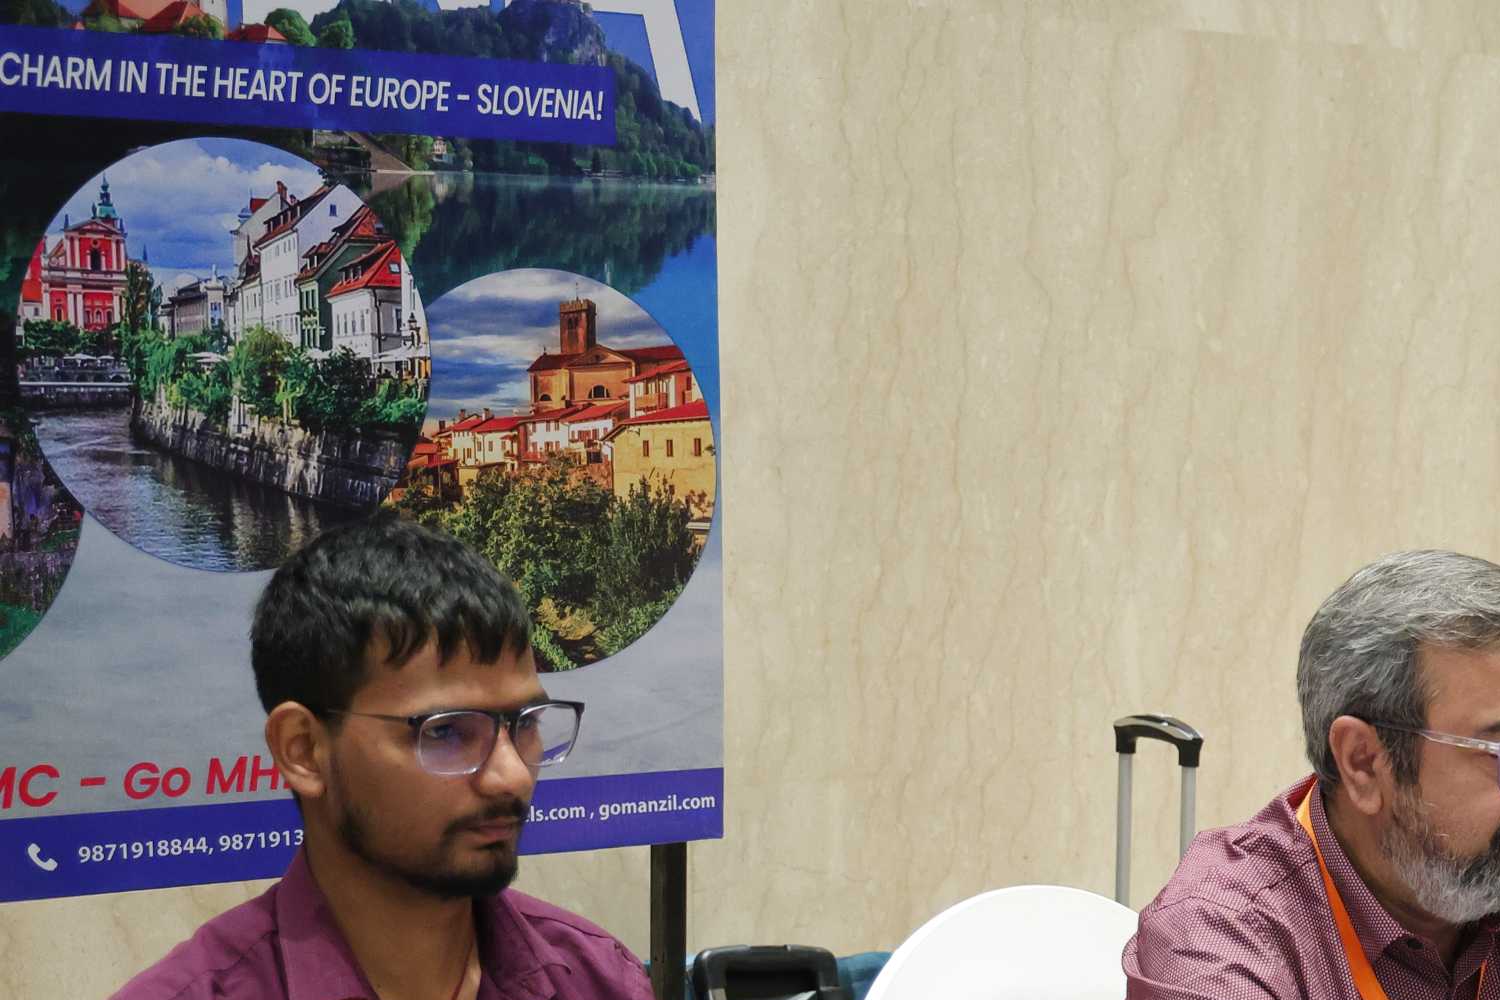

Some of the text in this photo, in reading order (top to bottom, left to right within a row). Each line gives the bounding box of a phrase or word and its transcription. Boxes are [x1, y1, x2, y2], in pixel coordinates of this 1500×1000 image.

[0, 52, 112, 92] CHARM
[118, 60, 149, 94] IN
[156, 63, 208, 97] THE
[213, 67, 304, 103] HEART
[308, 73, 346, 105] OF
[350, 75, 451, 112] EUROPE
[477, 84, 604, 121] SLOVENIA!
[124, 762, 191, 800] Go
[206, 755, 291, 794] MH
[525, 805, 586, 822] ls.com
[599, 794, 715, 820] gomanzil.com
[78, 836, 214, 864] 9871918844,
